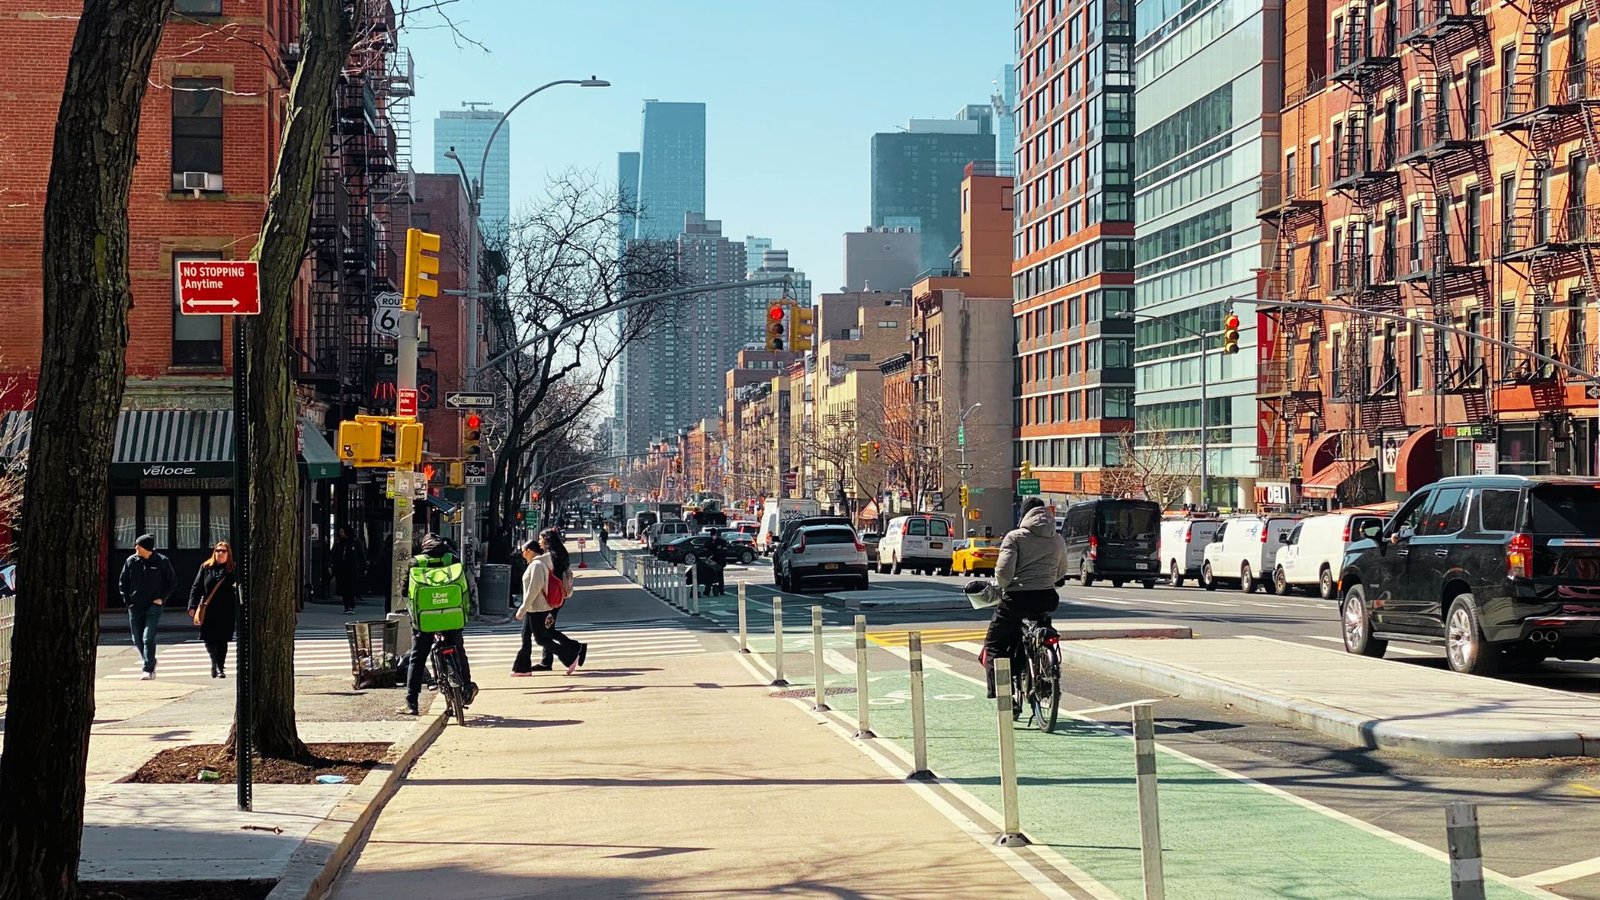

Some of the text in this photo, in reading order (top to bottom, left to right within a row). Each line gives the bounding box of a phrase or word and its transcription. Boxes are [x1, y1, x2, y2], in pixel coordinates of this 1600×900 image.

[183, 267, 245, 277] NO STOPPING
[185, 279, 223, 291] Anytime
